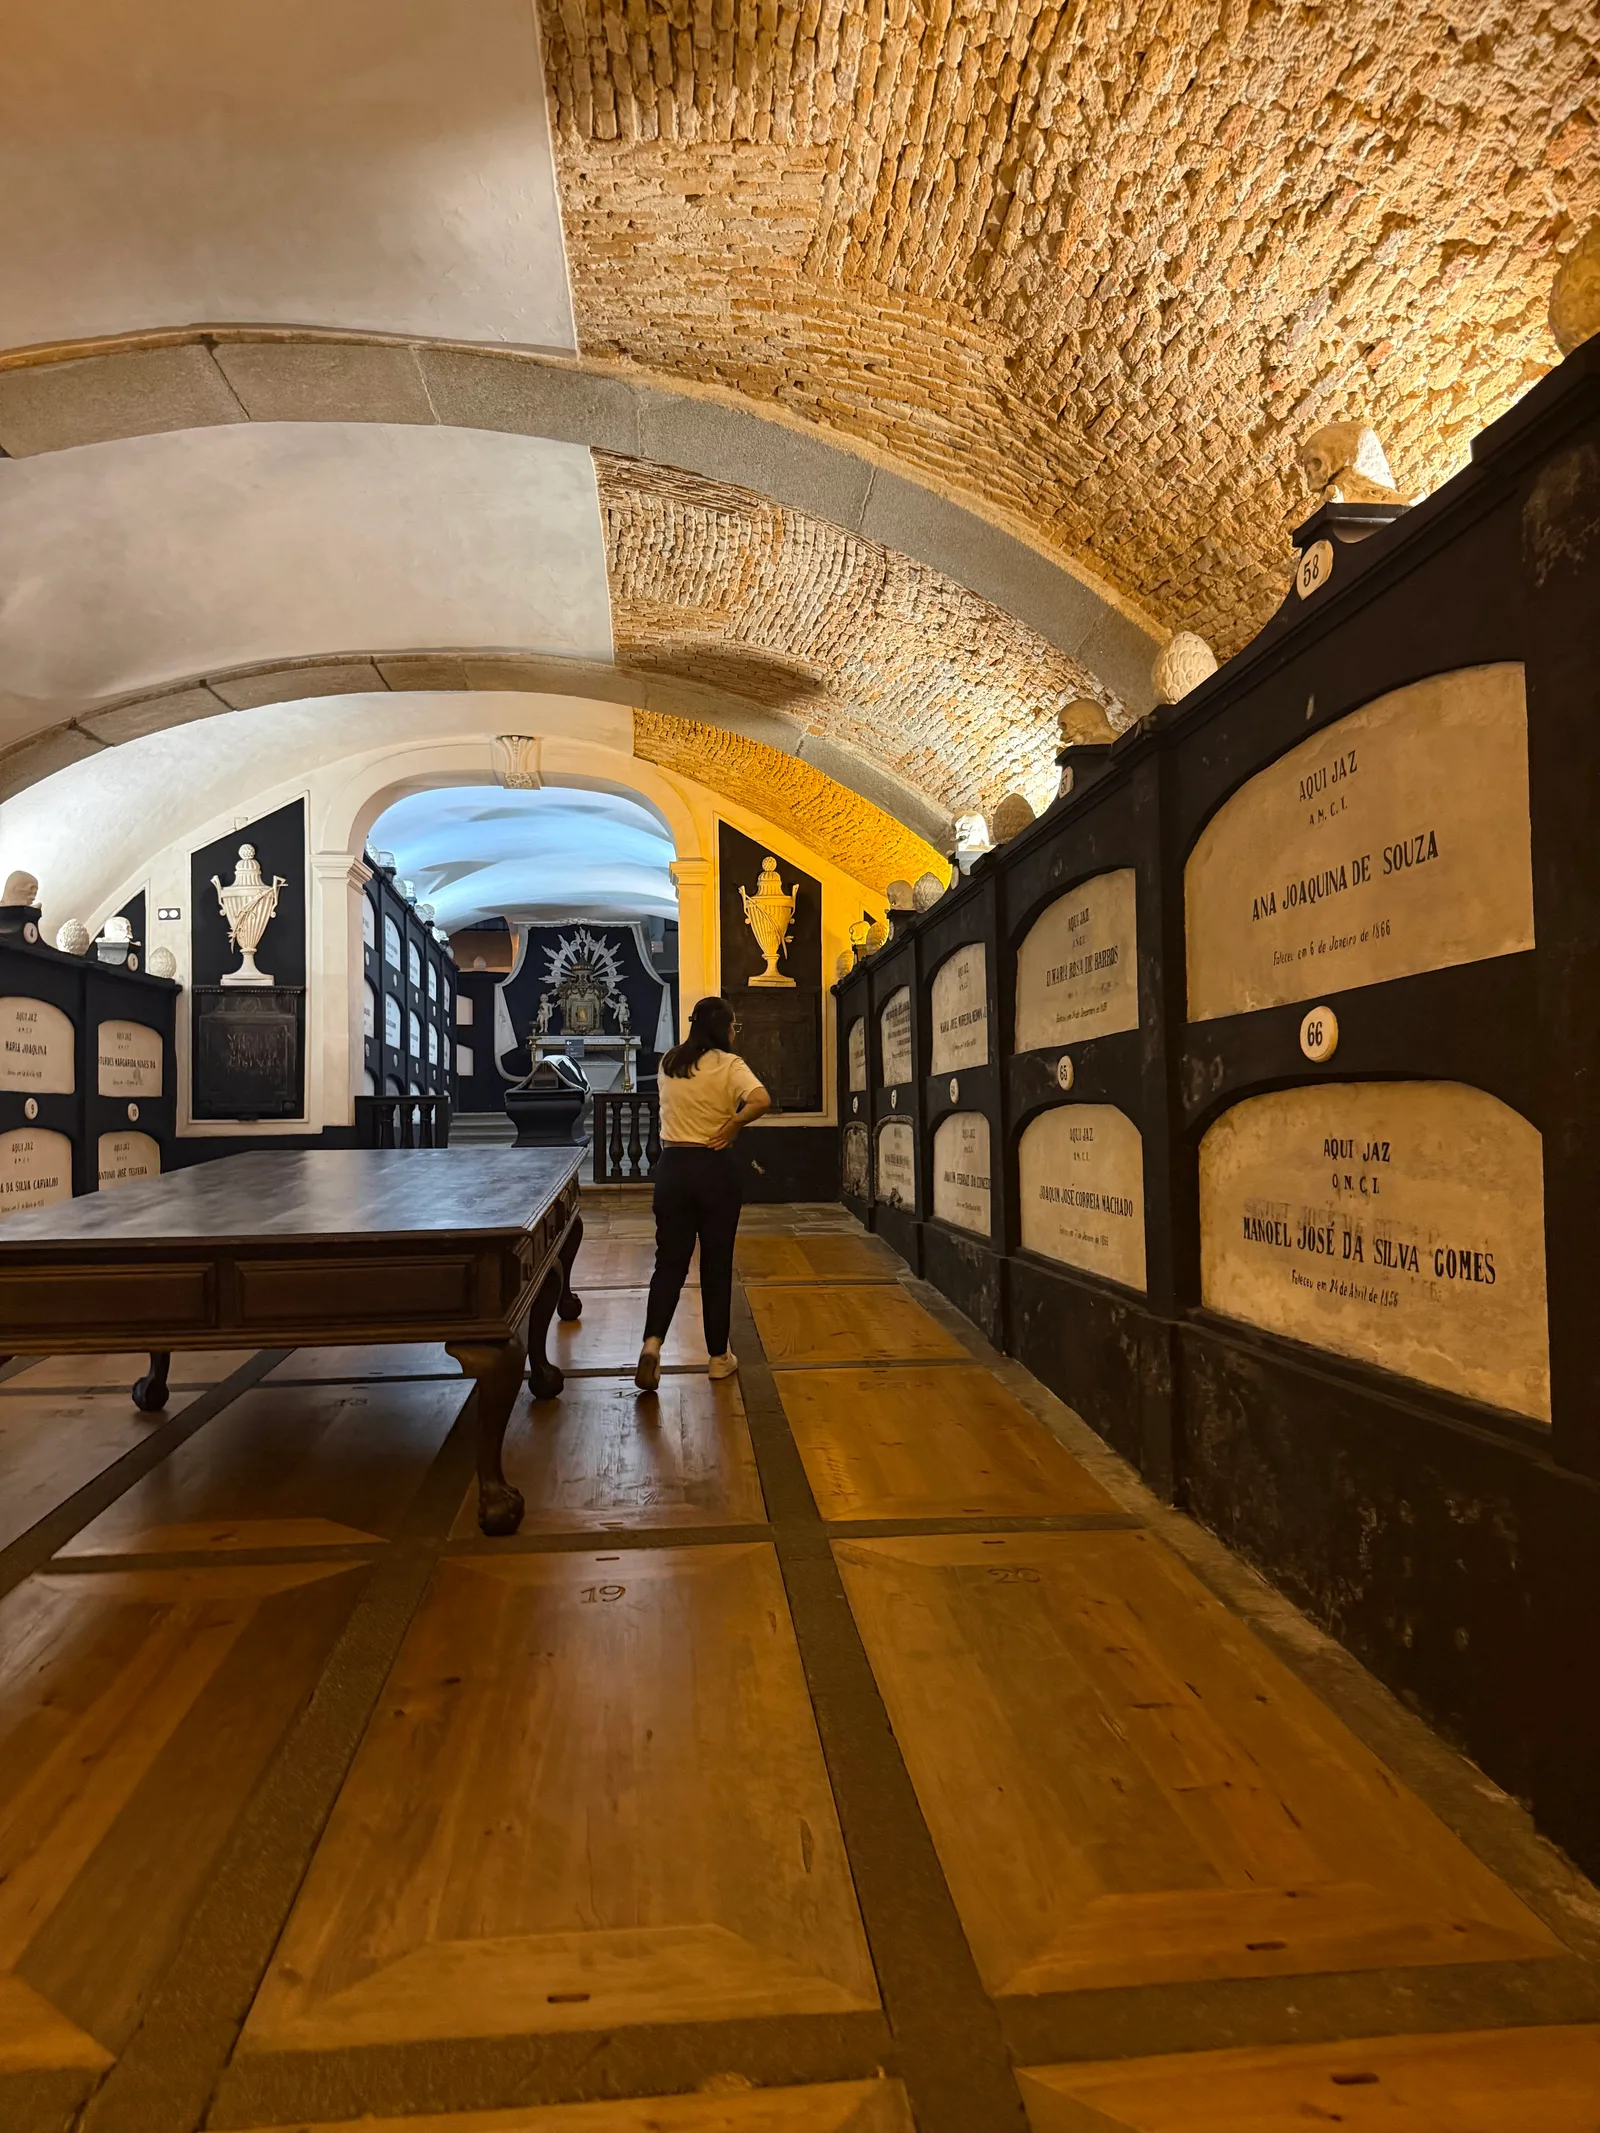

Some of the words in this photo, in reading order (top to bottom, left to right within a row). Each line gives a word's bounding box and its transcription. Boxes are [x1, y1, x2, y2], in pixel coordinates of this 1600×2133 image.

[1303, 554, 1319, 587] 58
[1300, 767, 1327, 802] AQUI
[1332, 750, 1357, 783] JAZ
[1252, 891, 1277, 921] ANA
[1283, 865, 1348, 910] JOAQUINA
[1352, 854, 1371, 886] DE
[1383, 830, 1439, 875] SOUZA
[1310, 941, 1315, 956] 6
[1360, 929, 1369, 942] de
[1372, 919, 1391, 939] 1866
[1307, 1021, 1323, 1047] 66
[1324, 1138, 1353, 1161] AQUI
[1362, 1142, 1390, 1163] JAZ
[1075, 1191, 1100, 1211] CORREIA
[1101, 1195, 1133, 1218] MACHADO
[1243, 1216, 1292, 1248] MANOEL
[1297, 1221, 1335, 1256] JOSÉ
[1342, 1231, 1364, 1263] DA
[1374, 1238, 1420, 1273] SILVA
[1434, 1248, 1497, 1285] GOMES
[1316, 1281, 1327, 1292] em
[1339, 1281, 1348, 1297] de
[1349, 1282, 1367, 1301] Abril
[1368, 1287, 1378, 1304] de
[988, 1567, 1041, 1583] 20
[581, 1585, 625, 1604] 19
